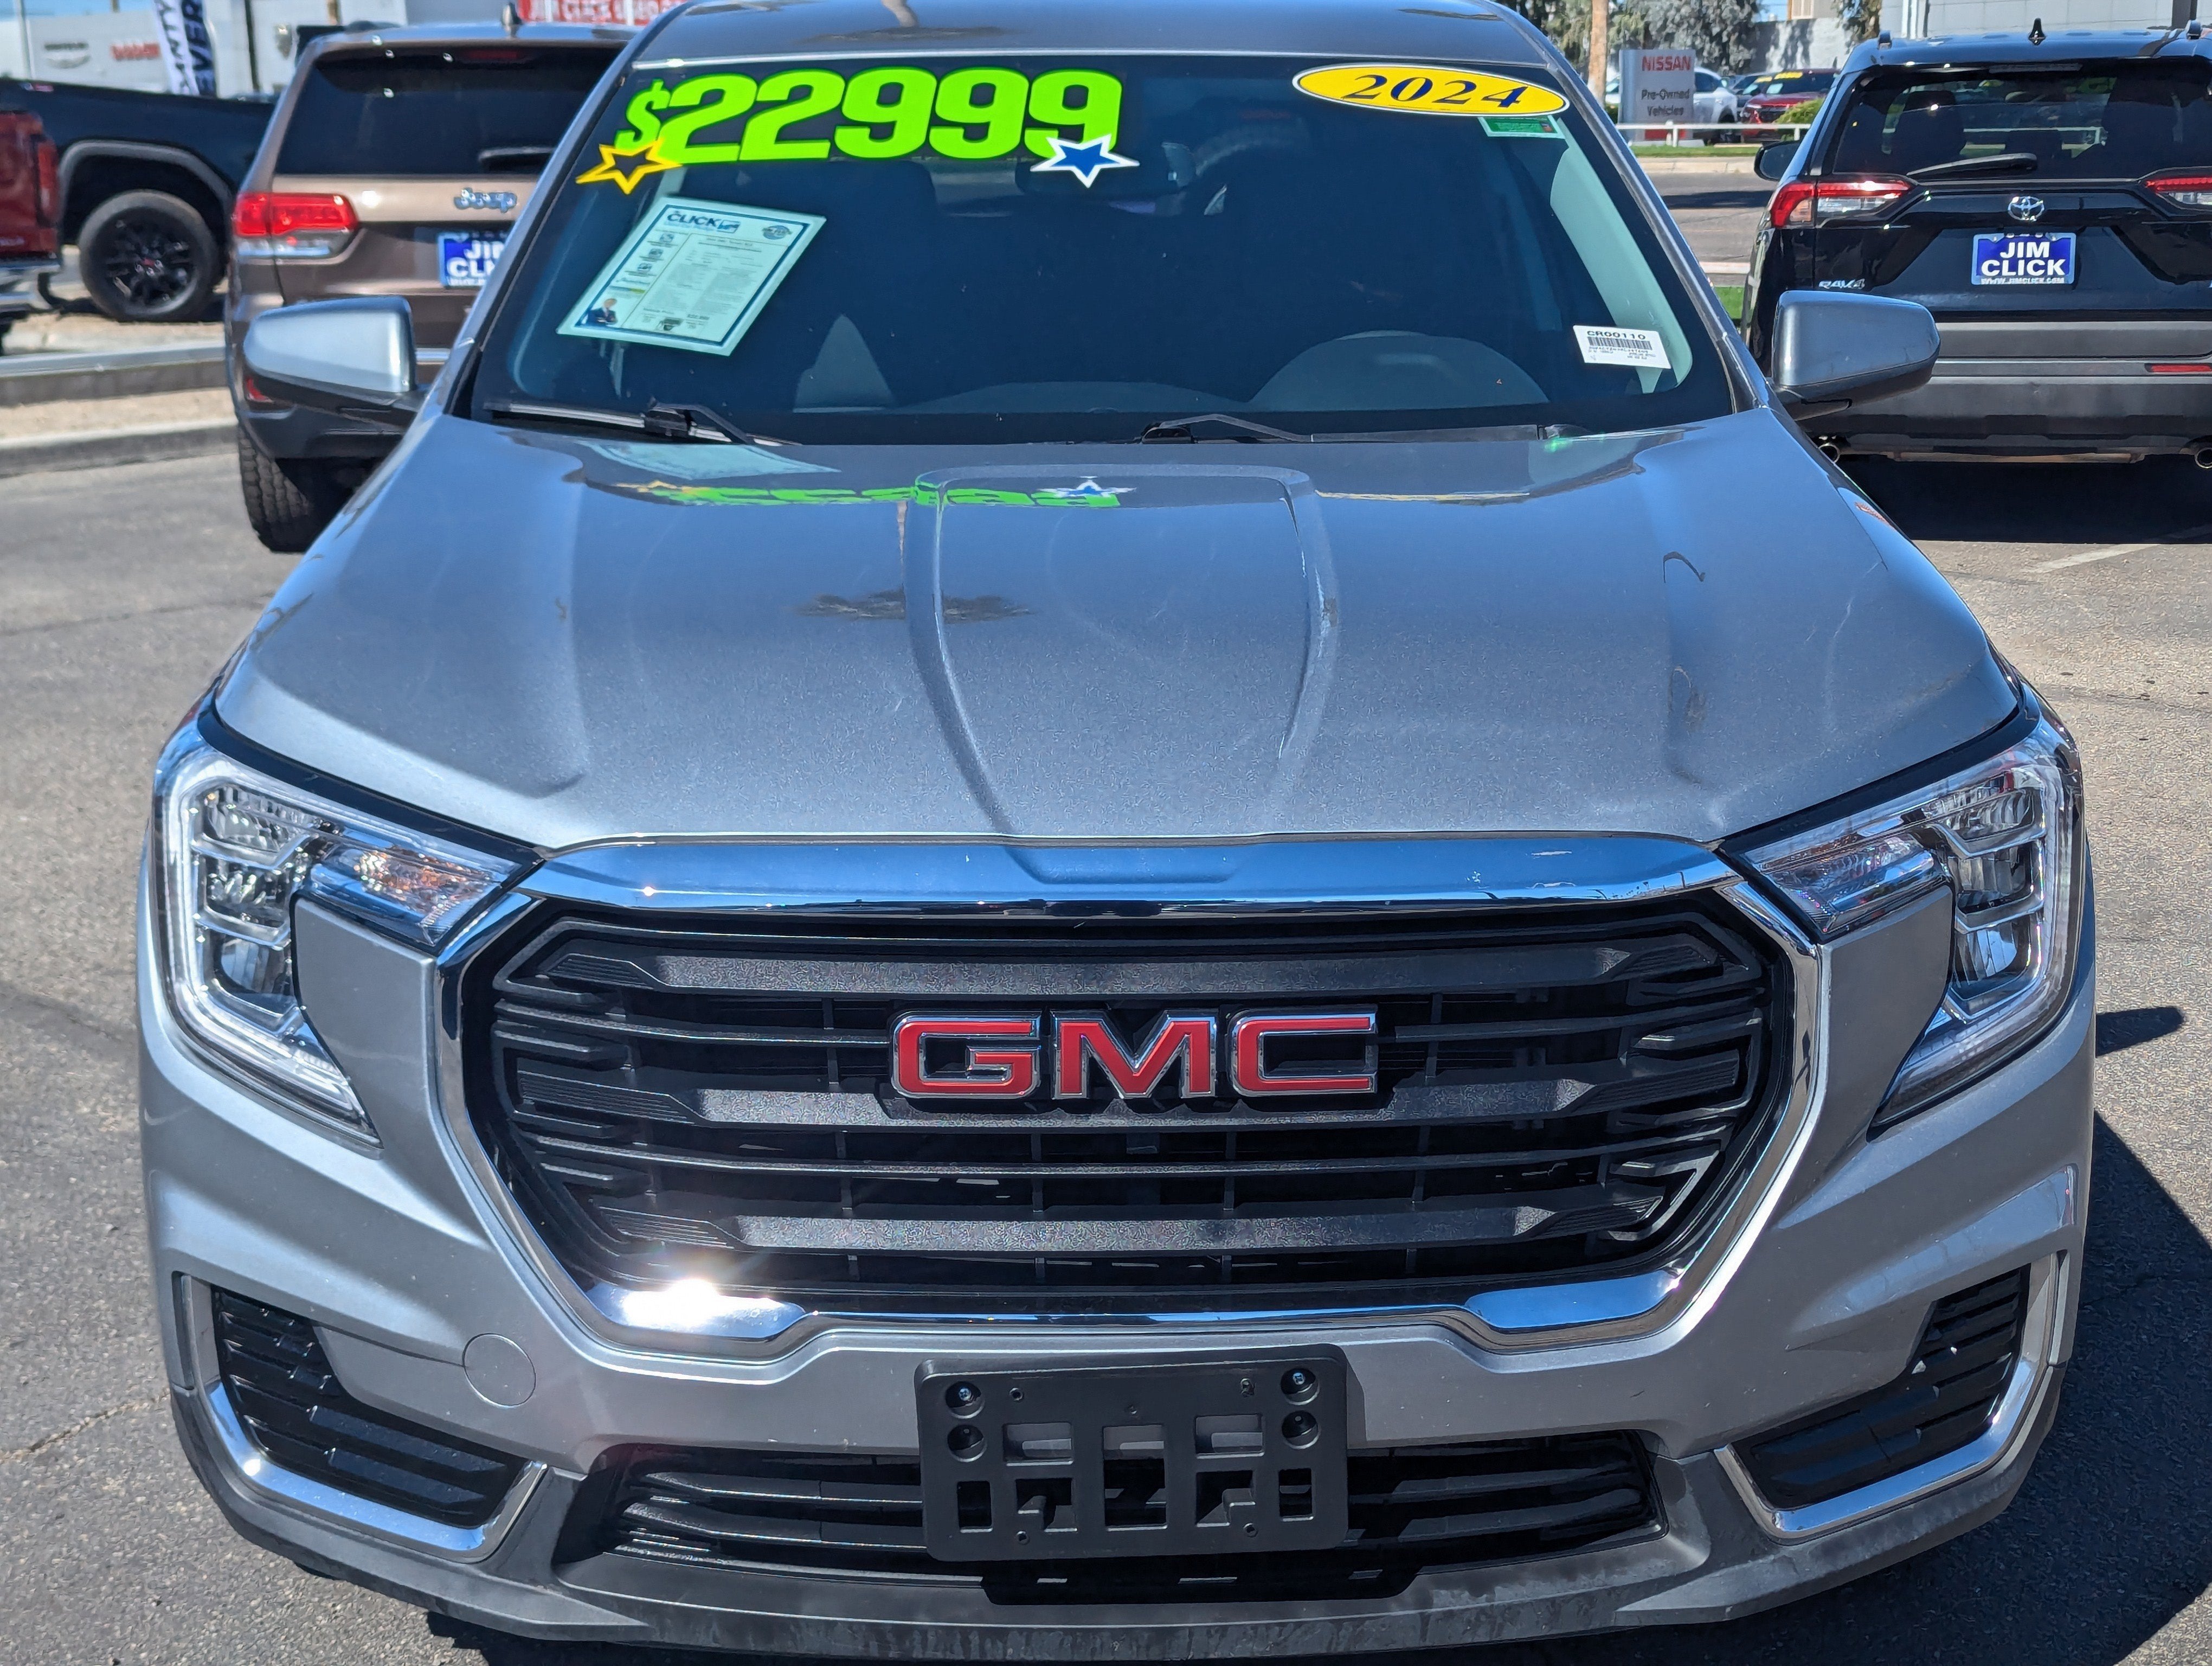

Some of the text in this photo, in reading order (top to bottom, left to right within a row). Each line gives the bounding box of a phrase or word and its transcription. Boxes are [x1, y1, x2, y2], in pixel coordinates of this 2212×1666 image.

[1642, 55, 1692, 71] NISSAN
[1342, 74, 1529, 108] 2024
[1641, 88, 1690, 100] Pre-Owned
[614, 66, 1124, 164] $22999
[1647, 105, 1684, 117] Vehicles
[667, 213, 722, 227] CLICK
[1999, 241, 2050, 259] JIM
[1981, 259, 2066, 277] CLICK
[1587, 330, 1646, 340] CR00110
[890, 1012, 1378, 1100] GMC
